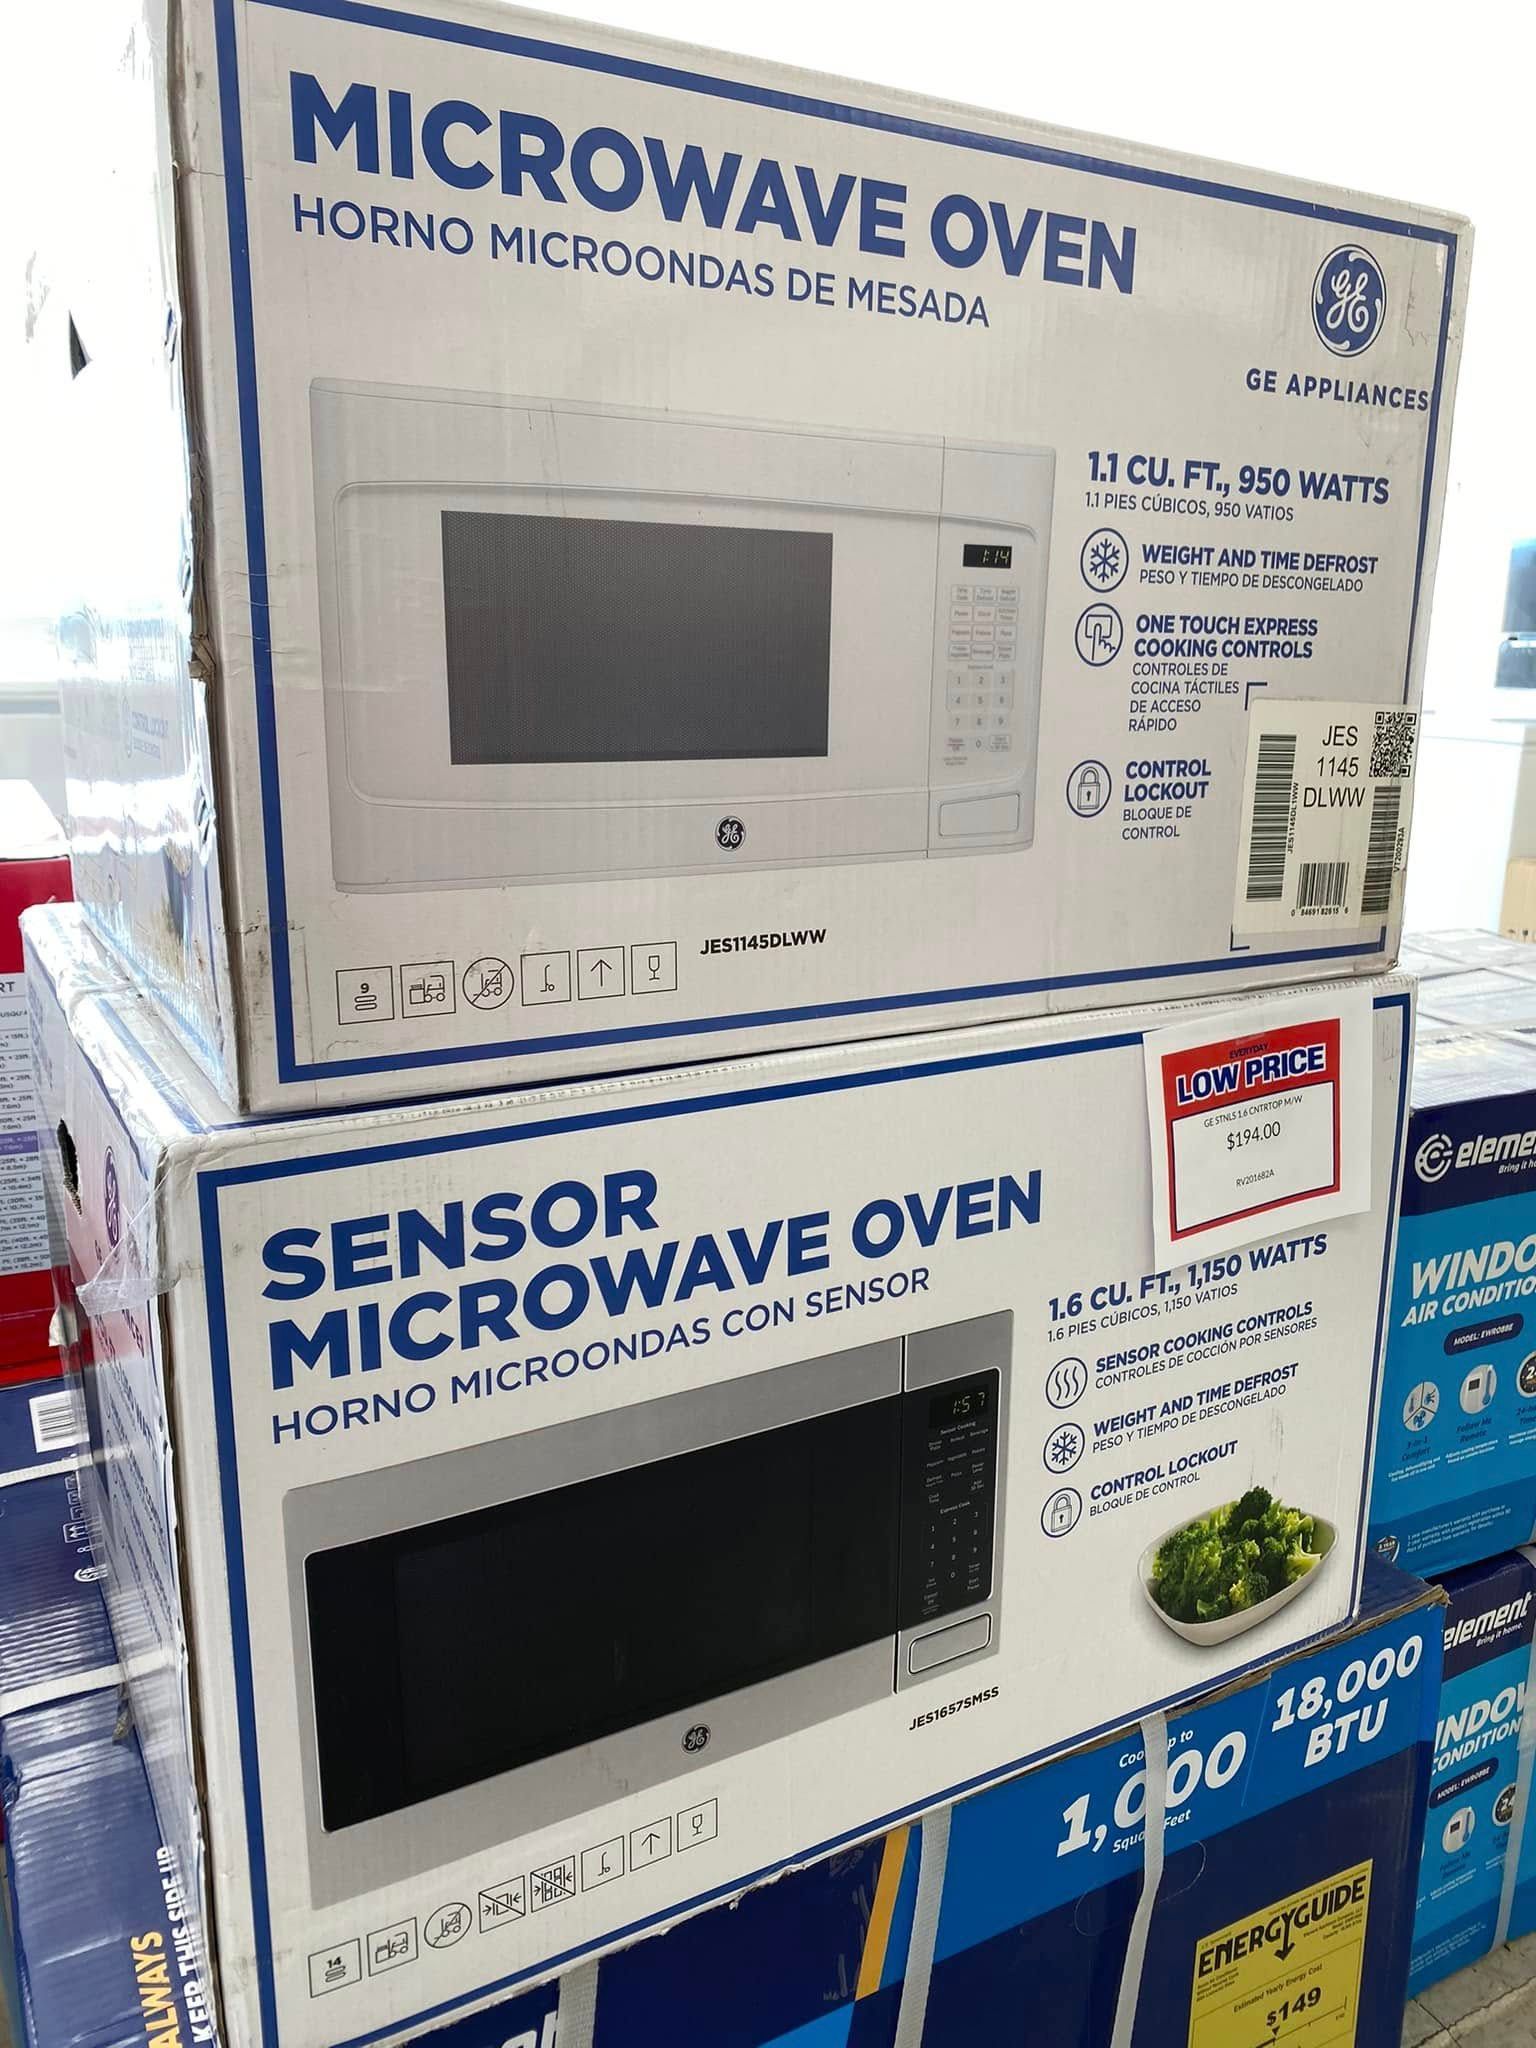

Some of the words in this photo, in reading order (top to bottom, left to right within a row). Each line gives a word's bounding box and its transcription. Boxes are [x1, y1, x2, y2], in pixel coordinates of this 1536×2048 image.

[289, 70, 907, 258] MICROWAVE
[930, 193, 1137, 295] OVEN
[293, 193, 473, 255] HORNO
[490, 222, 775, 298] MICROONDAS
[787, 267, 836, 306] DE
[847, 276, 990, 328] MESADA
[1245, 367, 1277, 393] GE
[1285, 372, 1429, 412] APPLIANCES
[1088, 450, 1118, 483] 1.1
[1126, 454, 1175, 488] CU.
[1239, 465, 1291, 496] 950
[1299, 470, 1389, 504] WATTS
[1085, 491, 1099, 508] 1.1
[1104, 493, 1137, 510] PIES
[1141, 493, 1210, 518] CÚBICOS,
[1214, 502, 1241, 517] 950
[1246, 504, 1294, 521] VATIOS
[982, 549, 1010, 565] 1:14
[1141, 543, 1215, 567] WEIGHT
[1217, 549, 1256, 569] AND
[1260, 551, 1300, 571] TIME
[1303, 553, 1378, 575] DEFROST
[1139, 569, 1175, 585] PESO
[1178, 571, 1187, 585] Y
[1191, 571, 1239, 587] TIEMPO
[1242, 574, 1259, 588] DE
[1262, 574, 1364, 593] DESCONGELADO
[1136, 614, 1175, 633] ONE
[1179, 615, 1241, 634] TOUCH
[1243, 617, 1318, 637] EXPRESS
[1132, 662, 1209, 676] CONTROLES
[1212, 663, 1229, 676] DE
[1134, 638, 1217, 657] COOKING
[1221, 639, 1313, 659] CONTROLS
[1129, 700, 1147, 714] DE
[1150, 700, 1202, 713] ACCESO
[1131, 681, 1180, 695] COCINA
[1184, 679, 1240, 695] TÁCTILES
[1128, 716, 1178, 732] RÁPIDO
[1322, 725, 1359, 746] JES
[1125, 759, 1212, 779] CONTROL
[1316, 756, 1360, 778] 1145
[1123, 781, 1210, 802] LOCKOUT
[1302, 786, 1366, 808] DLWW
[1121, 825, 1180, 840] CONTROL
[1122, 807, 1173, 821] BLOQUE
[1176, 806, 1192, 819] DE
[699, 929, 827, 956] JES1145DLWW
[360, 983, 370, 994] 9
[1229, 1043, 1269, 1059] EVERYDAY
[1177, 1065, 1240, 1105] LOW
[1245, 1045, 1325, 1086] PRICE
[1203, 1117, 1215, 1128] GE
[1214, 1110, 1238, 1125] STNLS
[1248, 1099, 1284, 1117] CNTRTOP
[1284, 1095, 1303, 1107] M/W
[1226, 1121, 1281, 1152] $194.00
[1455, 1130, 1536, 1169] eleme
[1498, 1163, 1520, 1174] Bring
[1520, 1160, 1528, 1170] it
[261, 1169, 658, 1301] SENSOR
[268, 1210, 830, 1391] MICROWAVE
[851, 1170, 1042, 1259] OVEN
[1048, 1291, 1083, 1322] 1.6
[1090, 1281, 1133, 1311] CU.
[1187, 1254, 1242, 1290] 1,150
[1248, 1233, 1328, 1272] WATTS
[1412, 1233, 1536, 1299] WINDO
[1047, 1329, 1064, 1343] 1.6
[1068, 1319, 1097, 1338] PIES
[1100, 1303, 1161, 1329] CÚBICOS,
[1164, 1295, 1192, 1313] 1,150
[1196, 1283, 1238, 1305] VATIOS
[1400, 1300, 1439, 1328] AIR
[1441, 1275, 1536, 1316] CONDITIO
[272, 1383, 436, 1444] HORNO
[450, 1316, 711, 1404] MICROONDAS
[721, 1297, 794, 1338] CON
[805, 1266, 930, 1318] SENSOR
[1095, 1341, 1160, 1373] SENSOR
[1163, 1324, 1233, 1355] COOKING
[1236, 1301, 1313, 1335] CONTROLS
[1095, 1362, 1166, 1390] CONTROLES
[1168, 1355, 1184, 1369] DE
[1186, 1340, 1236, 1364] COCCIÓN
[1238, 1333, 1261, 1349] POR
[1263, 1317, 1318, 1344] SENSORES
[1092, 1434, 1124, 1454] PESO
[1126, 1431, 1135, 1443] Y
[1136, 1417, 1179, 1440] TIEMPO
[1181, 1412, 1197, 1426] DE
[1199, 1384, 1287, 1421] DESCONGELADO
[1093, 1405, 1157, 1437] WEIGHT
[1159, 1395, 1193, 1418] AND
[1197, 1383, 1232, 1407] TIME
[1233, 1362, 1299, 1396] DEFROST
[1090, 1465, 1165, 1500] CONTROL
[1168, 1439, 1239, 1475] LOCKOUT
[1089, 1495, 1133, 1517] BLOQUE
[1135, 1490, 1150, 1503] DE
[1151, 1471, 1201, 1496] CONTROL
[1443, 1591, 1533, 1652] element
[1272, 1635, 1424, 1733] 18,000
[908, 1685, 1000, 1732] JES1657SMSS
[1434, 1681, 1528, 1754] INDO
[1119, 1750, 1145, 1769] Coo
[1180, 1729, 1194, 1743] to
[1303, 1697, 1389, 1768] BTU
[1056, 1730, 1247, 1857] 1,000
[1112, 1830, 1145, 1854] Squa
[1198, 1875, 1366, 1978] ENERGYGUIDE
[171, 1927, 197, 1978] THIS
[326, 1956, 342, 1968] 14
[130, 1931, 183, 2048] ALWAYS
[1285, 1972, 1307, 1988] Energy
[1307, 1963, 1323, 1977] Cost
[183, 1979, 214, 2044] KEEP
[1266, 1986, 1322, 2028] $149
